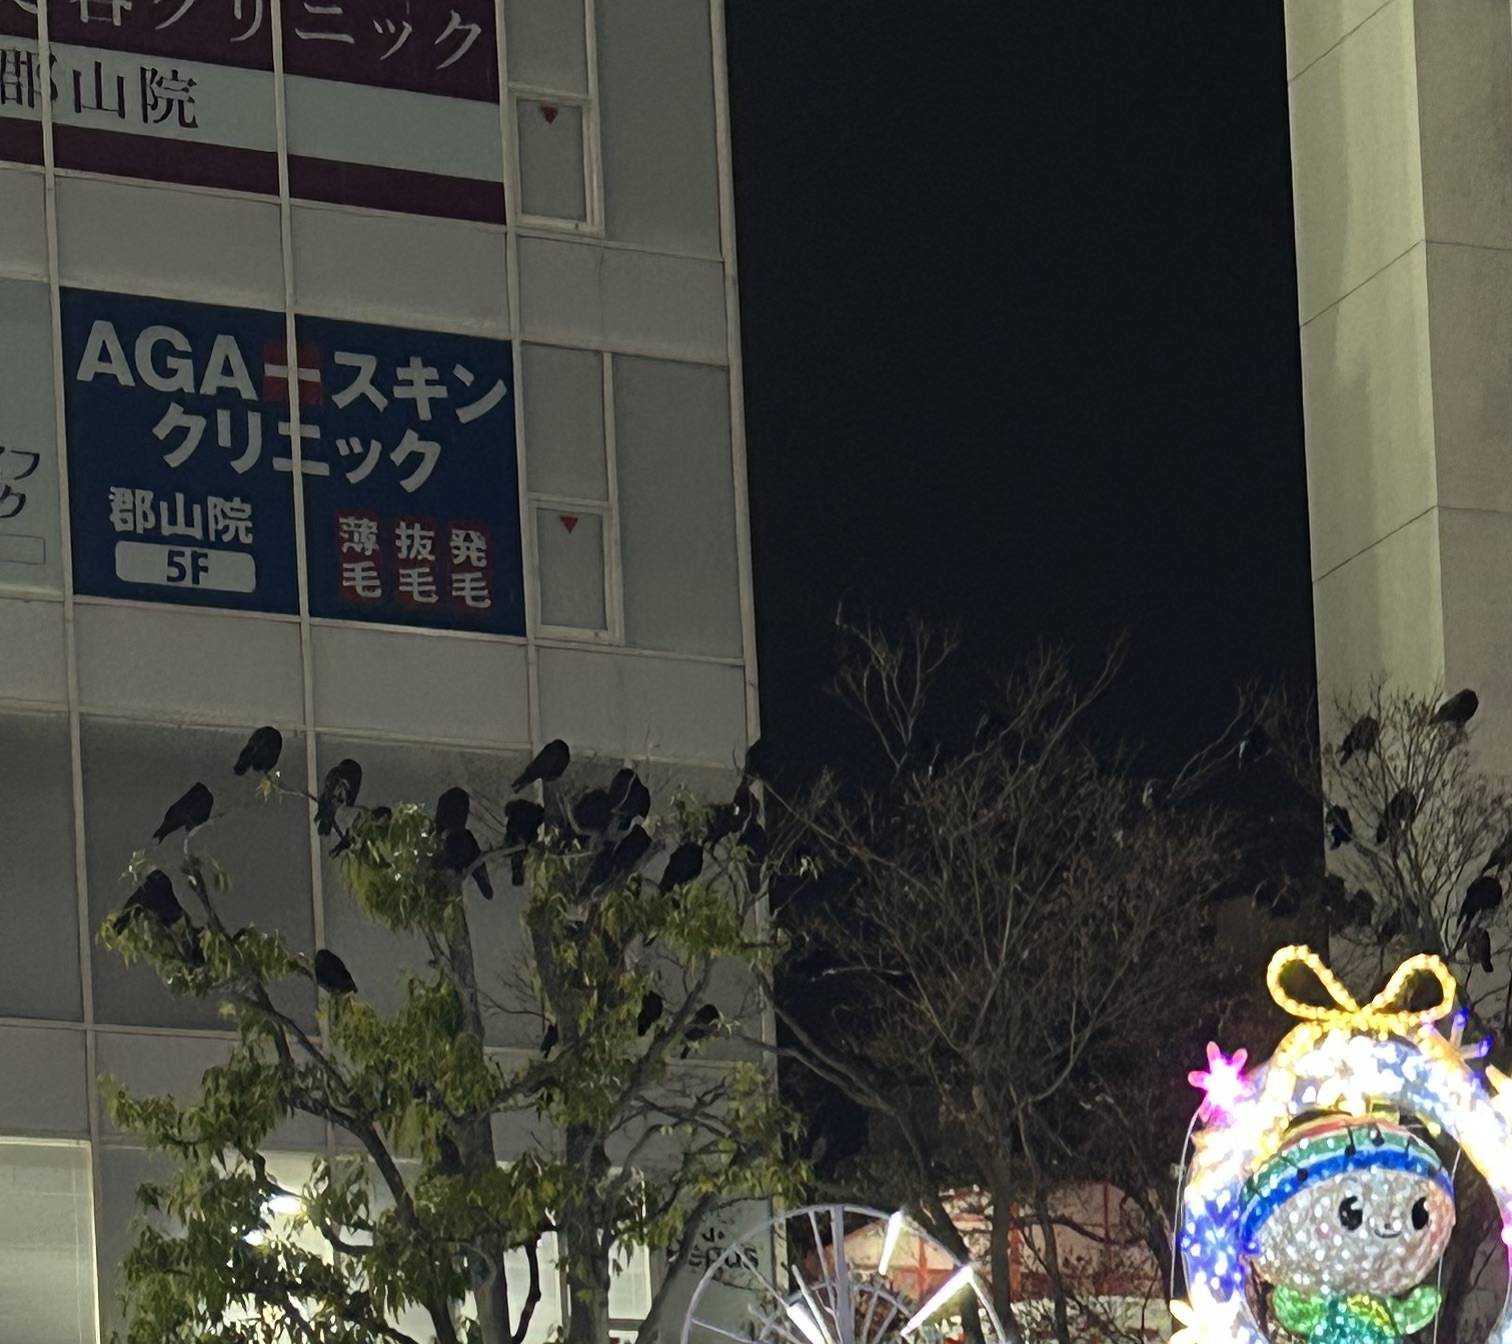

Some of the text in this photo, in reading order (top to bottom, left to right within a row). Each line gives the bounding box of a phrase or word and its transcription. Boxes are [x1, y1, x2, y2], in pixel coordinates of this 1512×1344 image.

[10, 0, 483, 71] リニック
[0, 48, 198, 129] 郡山院
[76, 320, 258, 401] AGA
[152, 402, 442, 493] クリニック
[109, 486, 254, 544] 郡山院
[166, 549, 209, 585] 5F
[339, 516, 382, 599] 薄毛
[395, 521, 439, 604] 抜毛
[450, 528, 491, 608] 発毛
